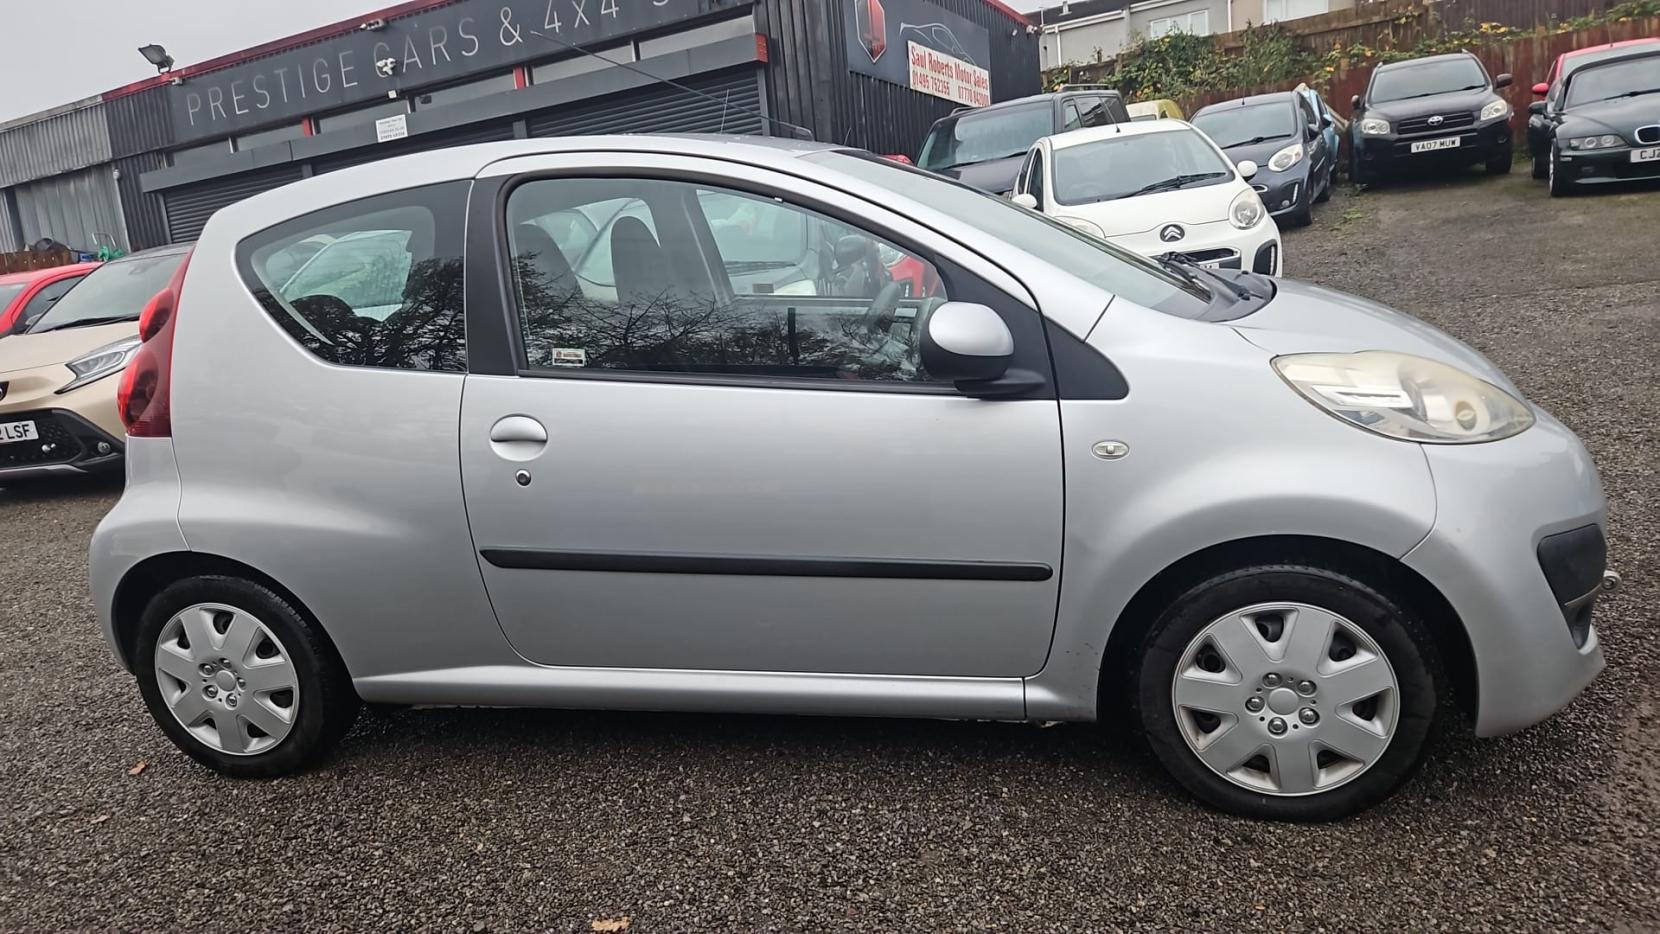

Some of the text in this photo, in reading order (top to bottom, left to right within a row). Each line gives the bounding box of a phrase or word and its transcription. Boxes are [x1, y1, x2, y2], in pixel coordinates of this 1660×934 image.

[187, 50, 358, 126] PRESTIGE
[373, 17, 479, 78] CARS
[500, 6, 523, 46] &
[911, 45, 988, 90] Saul Roberts Motor Sales
[1416, 139, 1456, 151] VA07 MUW
[5, 424, 30, 439] LSF
